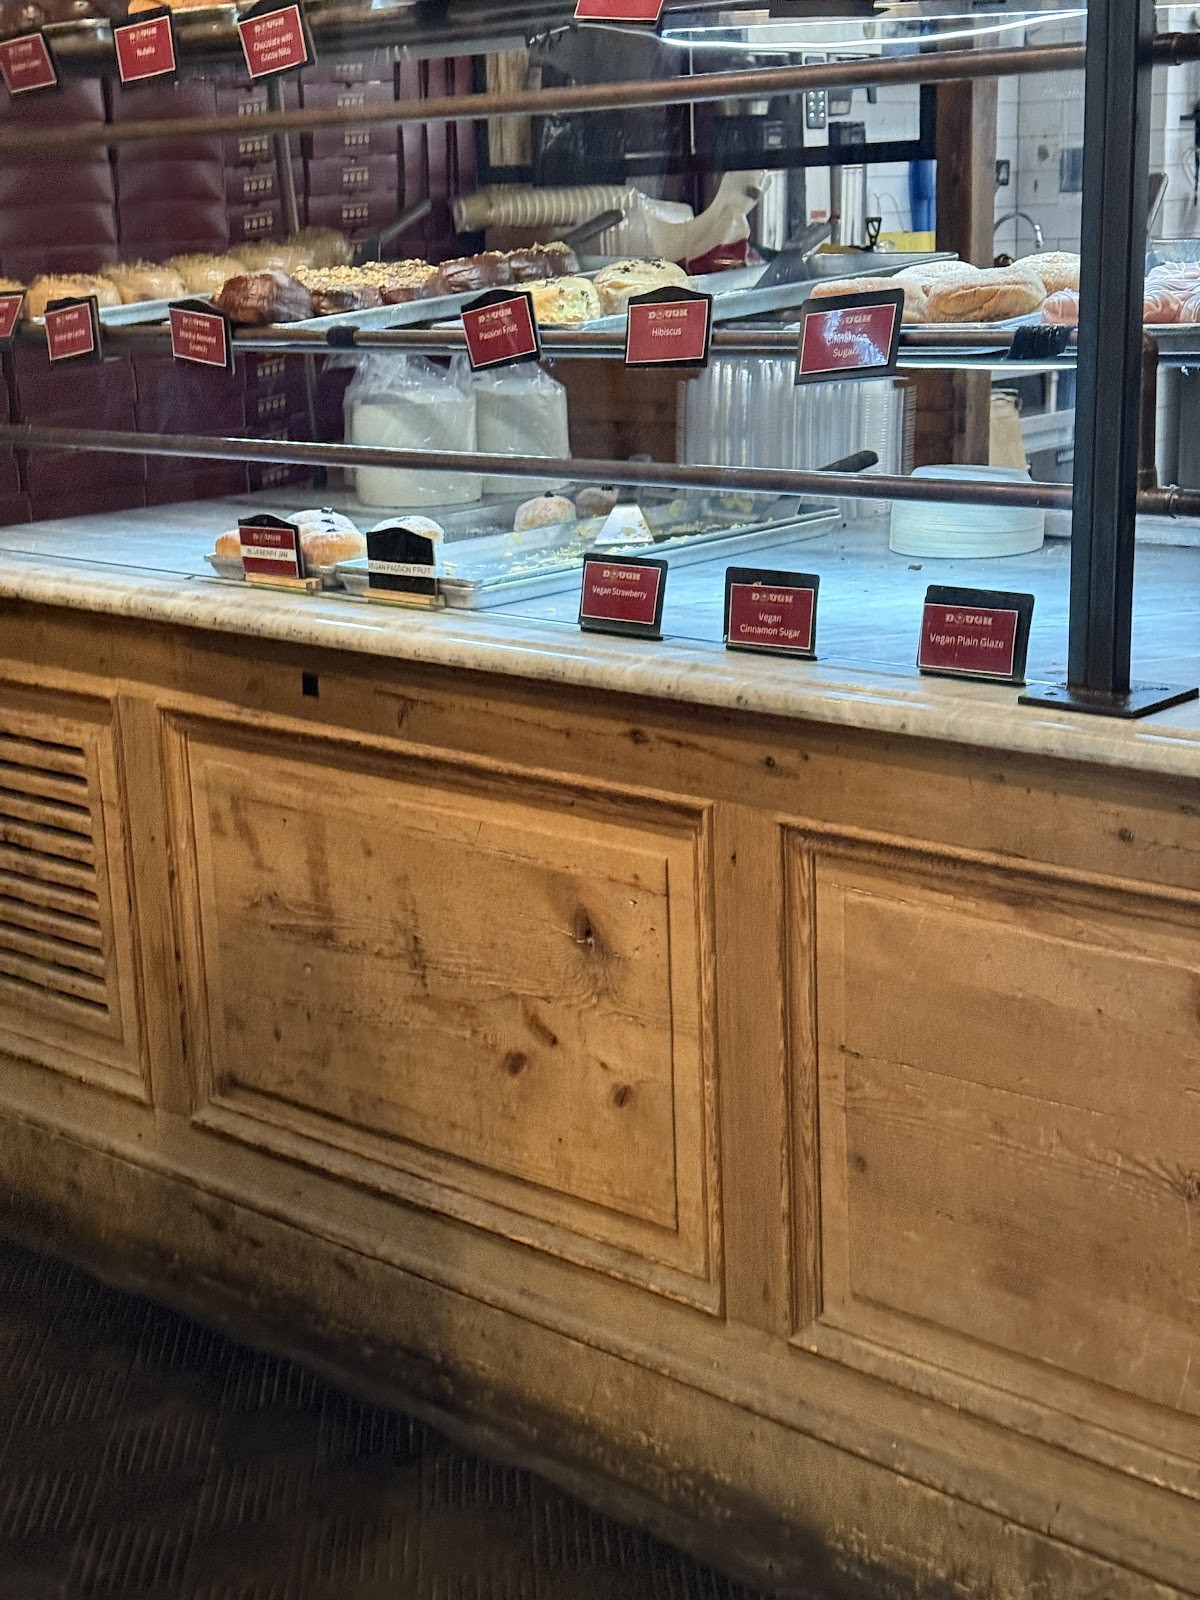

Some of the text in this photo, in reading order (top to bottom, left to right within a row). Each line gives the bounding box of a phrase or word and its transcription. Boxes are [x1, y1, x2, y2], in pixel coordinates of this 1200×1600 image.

[479, 324, 518, 340] Passion Fruit
[652, 327, 682, 337] Hibiscus
[412, 566, 431, 575] FRUIT
[592, 585, 647, 600] Vegan Strawberry
[758, 611, 782, 624] Vegan
[740, 624, 801, 639] Cinnamon Sugar
[929, 632, 1005, 650] Vegan Plain Glaze
